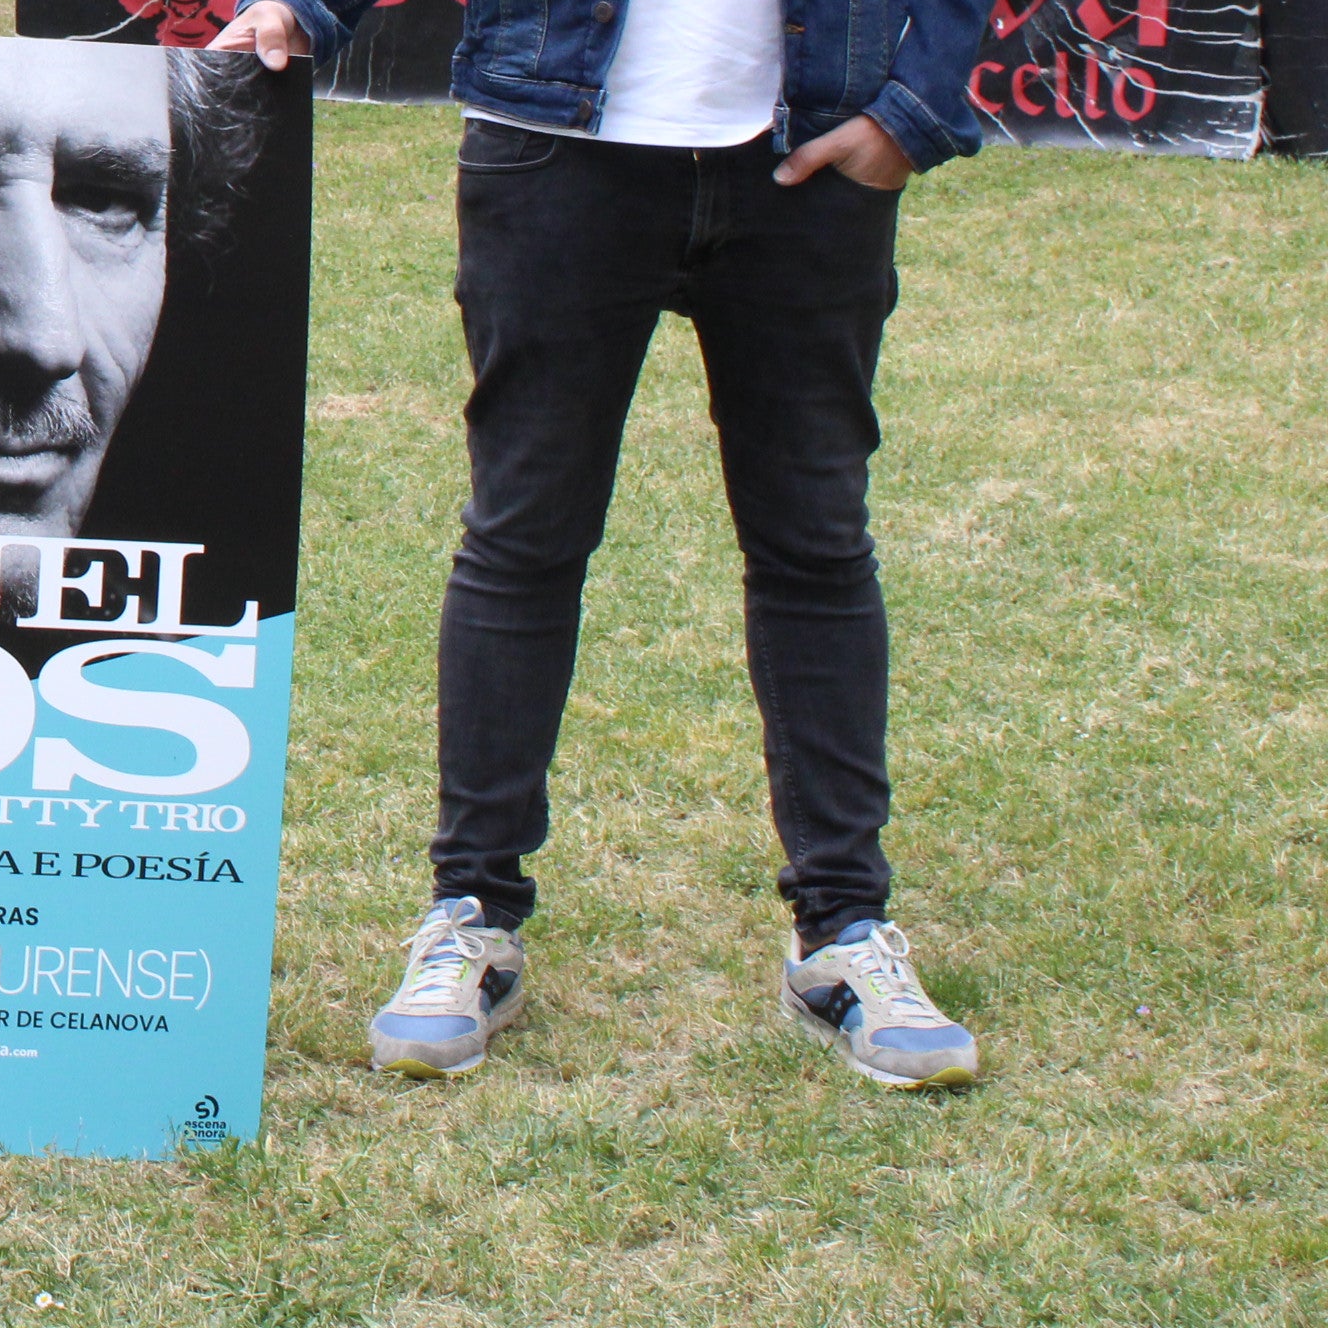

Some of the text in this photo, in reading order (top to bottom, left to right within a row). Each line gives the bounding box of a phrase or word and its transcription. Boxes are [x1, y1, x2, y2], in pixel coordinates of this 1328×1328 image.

[119, 800, 246, 833] TRIO
[32, 851, 61, 877] E
[72, 852, 244, 883] POESÍA
[17, 1010, 43, 1029] DE
[50, 1011, 169, 1032] CELANOVA
